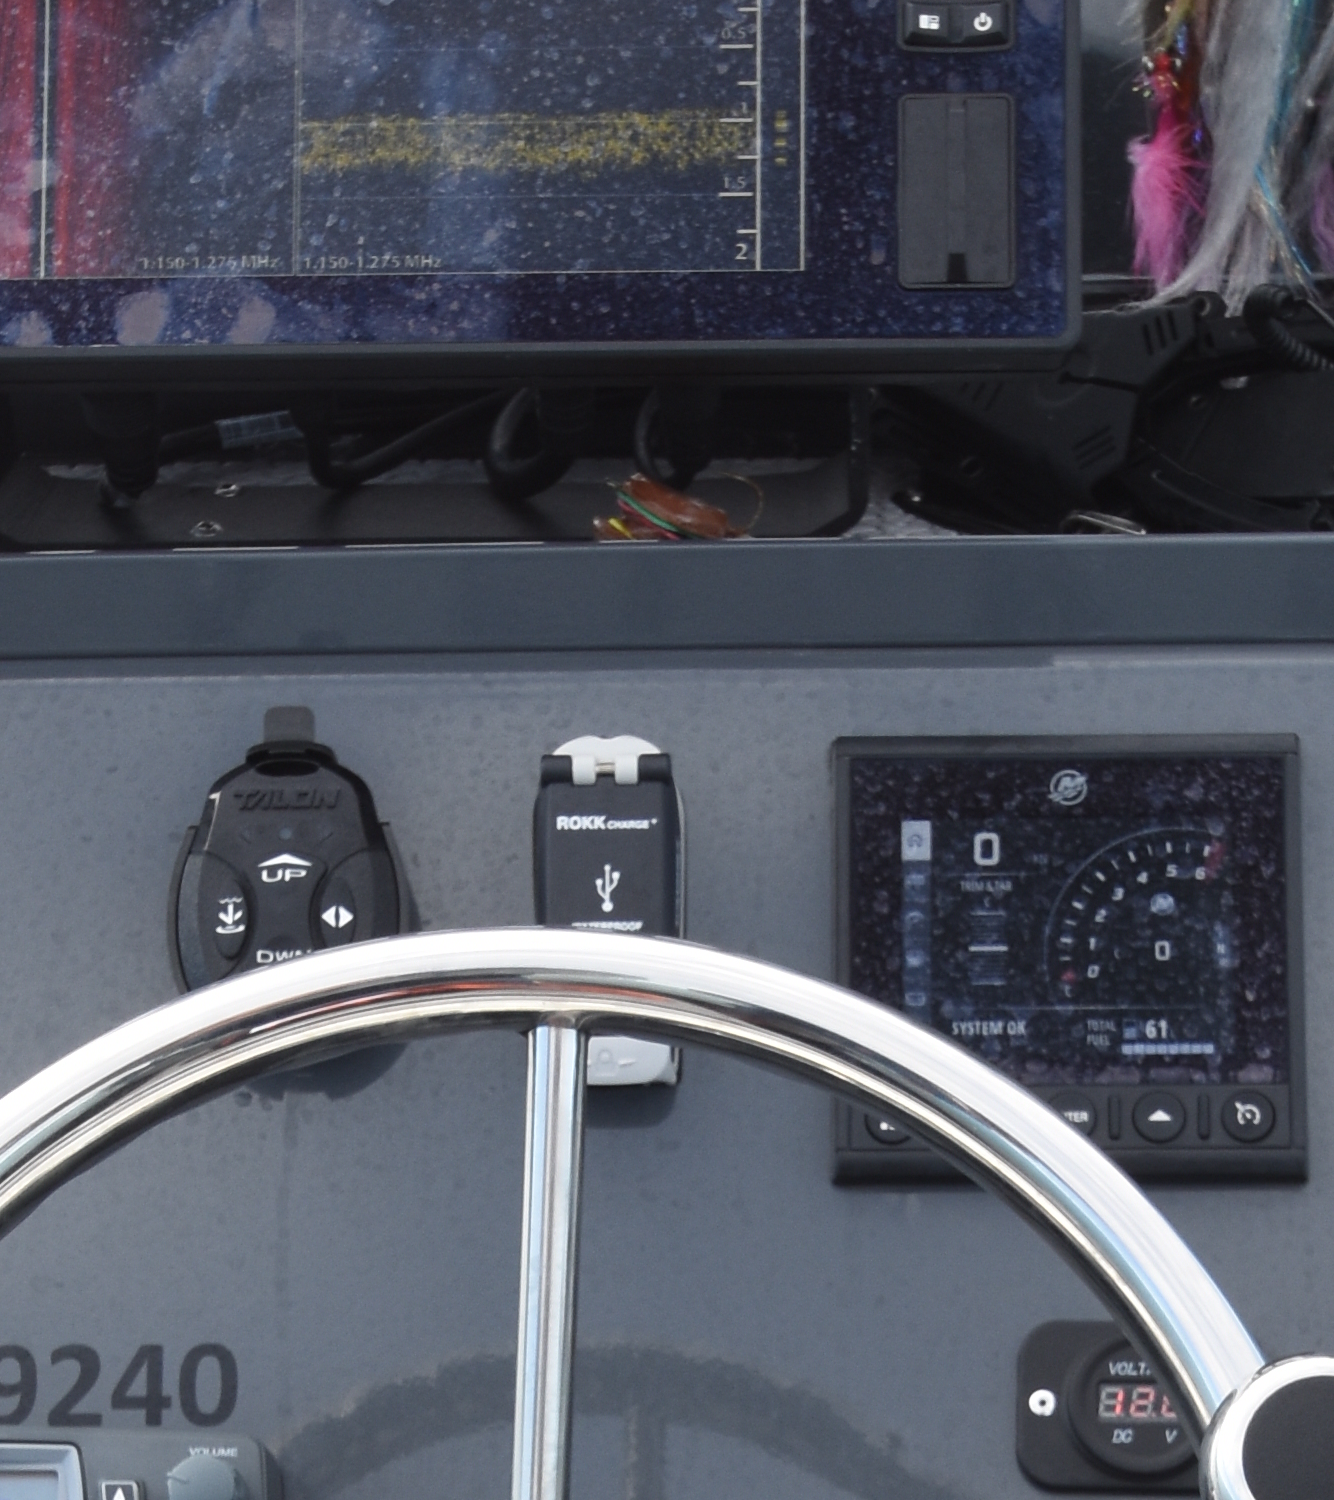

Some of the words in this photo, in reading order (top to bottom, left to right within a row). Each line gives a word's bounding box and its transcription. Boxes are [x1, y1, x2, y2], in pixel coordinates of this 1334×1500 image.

[735, 242, 749, 261] 2
[405, 255, 442, 268] MHz
[556, 815, 607, 830] ROKK
[973, 832, 1000, 866] 0
[261, 868, 307, 883] UP
[1136, 871, 1149, 884] 4
[1166, 864, 1178, 878] 5
[1195, 866, 1206, 881] 6
[1112, 887, 1125, 901] 3
[1095, 909, 1108, 923] 2
[1089, 937, 1097, 951] 1
[1154, 940, 1171, 961] 0
[1087, 964, 1100, 978] 0
[952, 1021, 1006, 1036] SYSTEM
[1007, 1020, 1026, 1036] OK
[1087, 1020, 1116, 1032] TOTAL
[1145, 1019, 1167, 1039] 61
[1063, 1111, 1089, 1123] TER
[1112, 1428, 1134, 1444] DC
[1165, 1429, 1179, 1444] V
[189, 1447, 239, 1458] VOLUME
